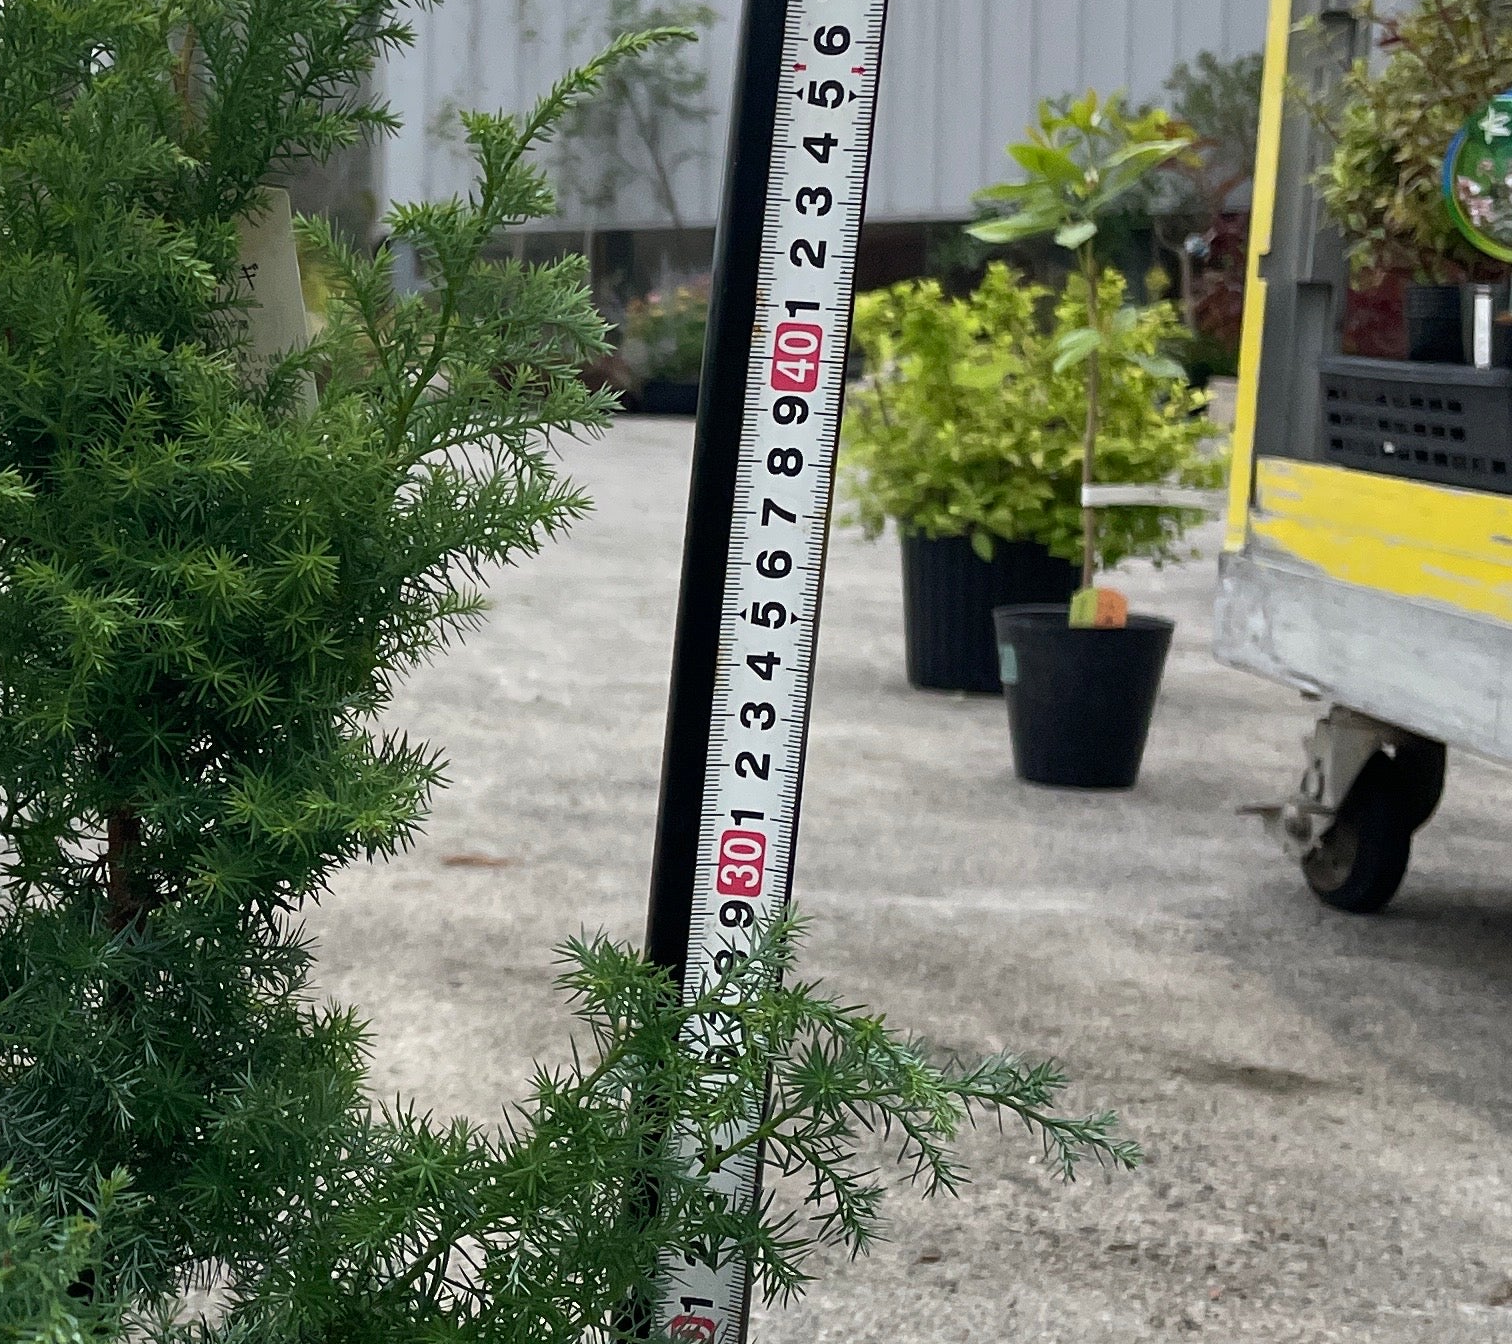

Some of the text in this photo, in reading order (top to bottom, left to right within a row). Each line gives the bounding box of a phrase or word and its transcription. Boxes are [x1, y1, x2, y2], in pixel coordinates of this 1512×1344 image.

[814, 26, 850, 55] 6
[808, 80, 844, 109] 5
[803, 133, 839, 163] 4
[796, 187, 832, 216] 3
[790, 239, 826, 268] 2
[785, 301, 820, 317] 1
[778, 333, 817, 382] 40
[773, 396, 808, 424] 9
[767, 448, 803, 477] 8
[761, 498, 796, 526] 7
[756, 551, 792, 578] 6
[750, 602, 786, 629] 5
[747, 652, 781, 680] 4
[740, 702, 775, 730] 3
[735, 752, 770, 780] 2
[731, 810, 765, 826] 1
[720, 838, 763, 888] 30
[719, 900, 754, 928] 9
[680, 1297, 714, 1312] 1
